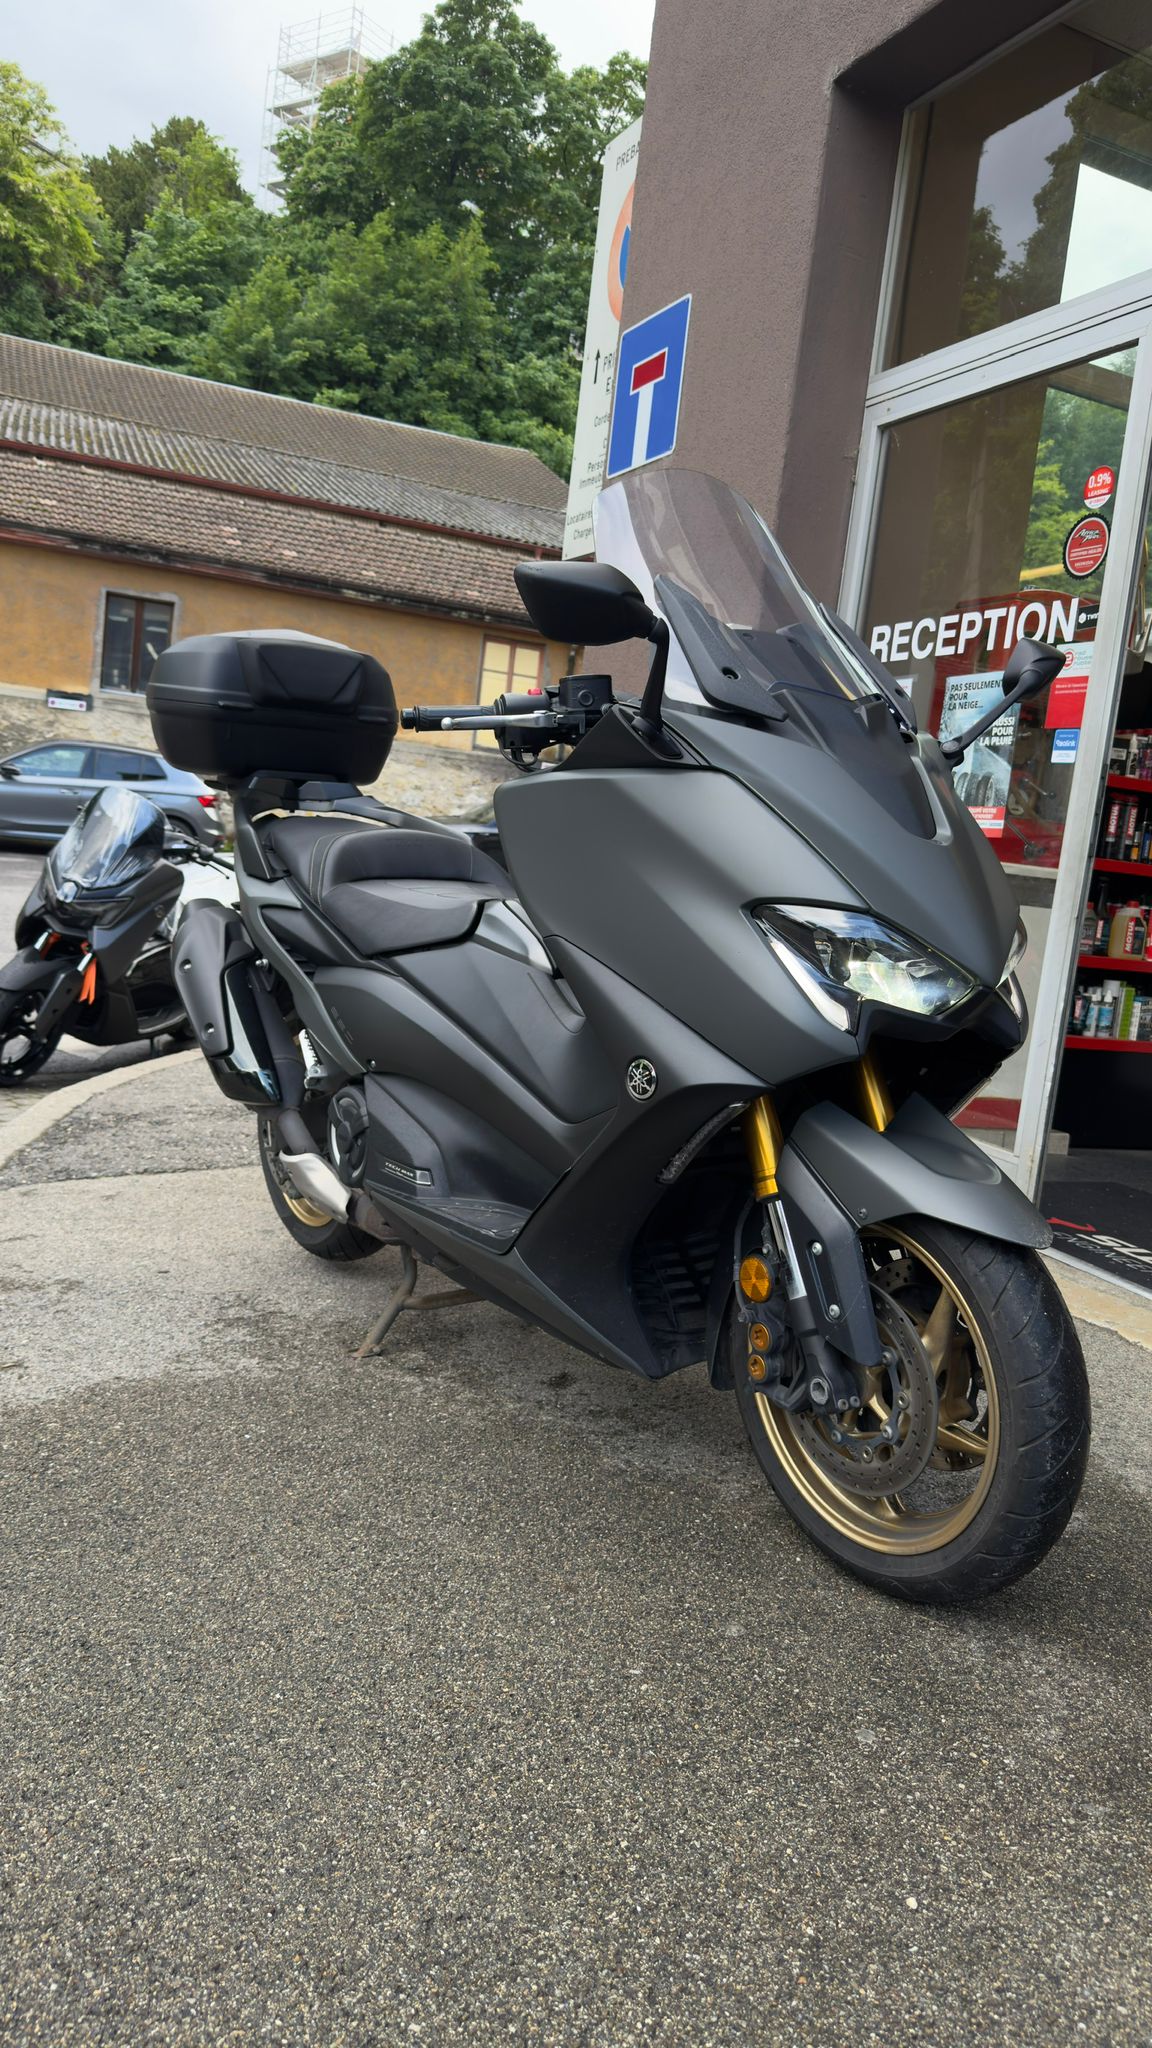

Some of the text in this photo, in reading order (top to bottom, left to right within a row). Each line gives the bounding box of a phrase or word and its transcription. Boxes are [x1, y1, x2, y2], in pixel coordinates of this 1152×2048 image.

[1088, 472, 1111, 489] 0.9%
[871, 598, 1079, 663] RECEPTION
[950, 680, 1002, 692] PAS SEULEMEN
[949, 692, 968, 701] POUR
[948, 702, 956, 711] LA
[992, 727, 1013, 736] POUR
[980, 735, 1012, 746] LA PLUIE
[1109, 804, 1120, 833] MOTUL
[1127, 807, 1138, 836] MOTUL
[1125, 920, 1135, 952] MOTUL
